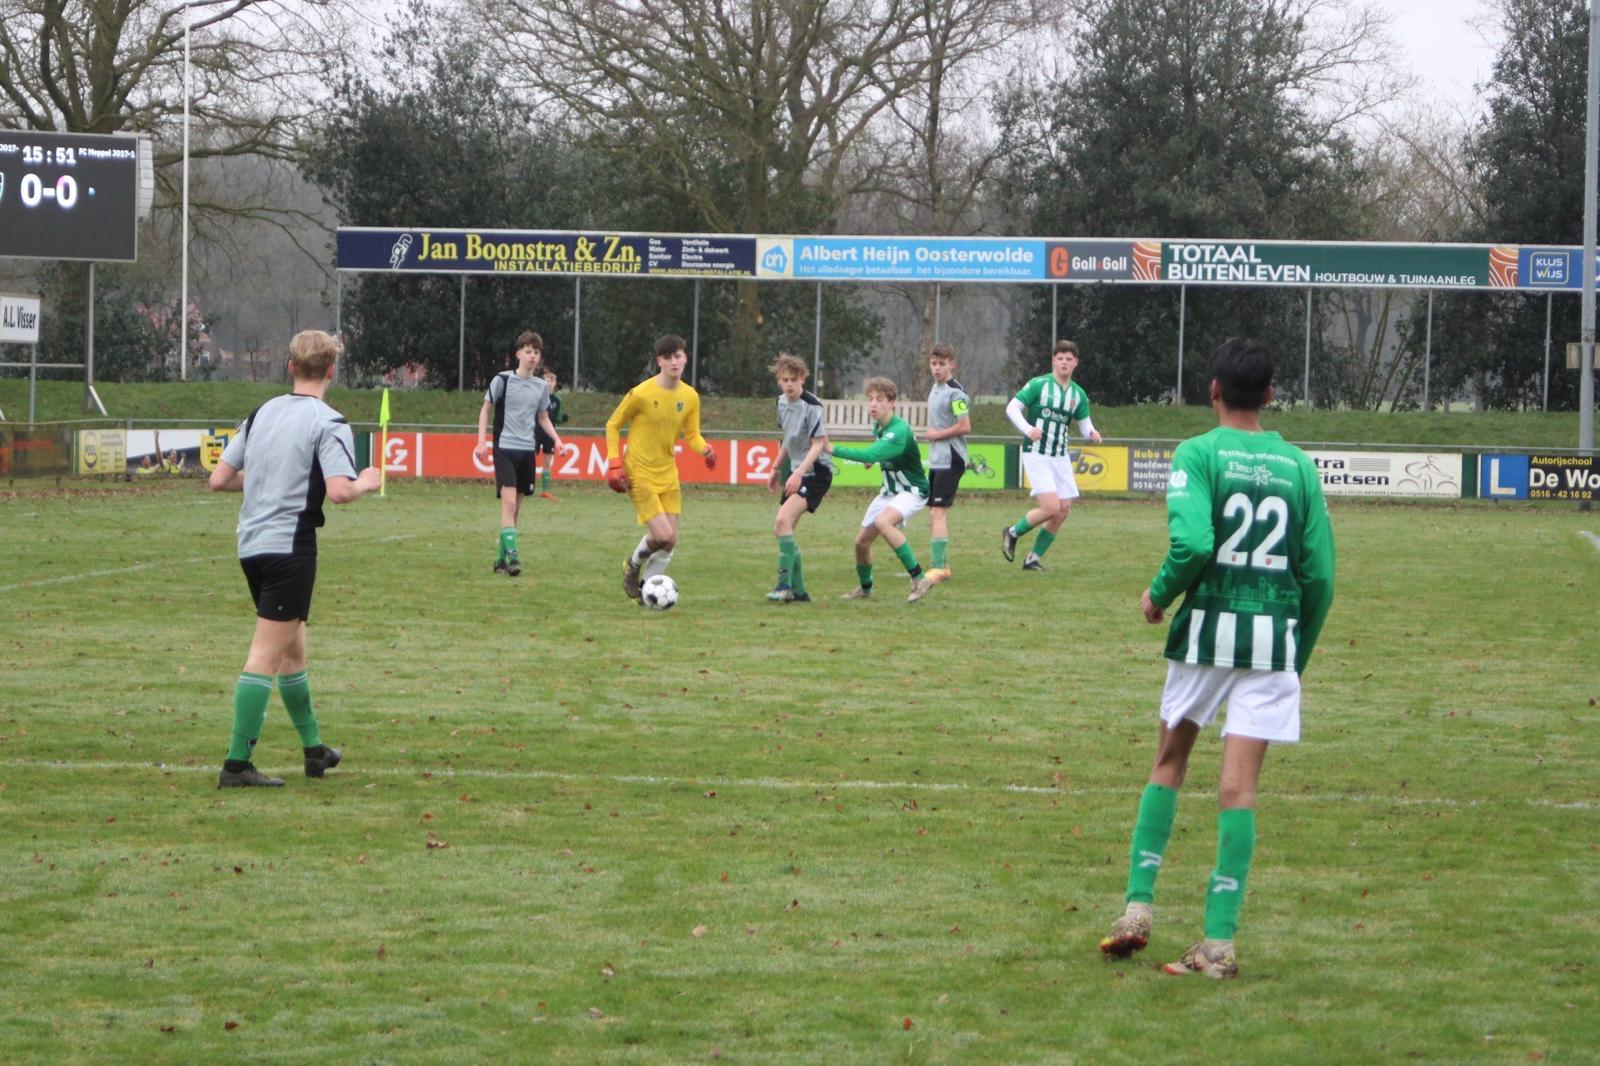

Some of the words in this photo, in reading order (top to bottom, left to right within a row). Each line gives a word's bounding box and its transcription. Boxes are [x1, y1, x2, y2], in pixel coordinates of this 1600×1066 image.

[20, 173, 78, 208] 0-0
[418, 233, 458, 260] Jan
[465, 234, 567, 261] Boonstra
[574, 236, 596, 262] &
[603, 236, 641, 262] Zn.
[800, 245, 858, 261] Albert
[863, 246, 910, 265] Heijn
[915, 247, 1034, 263] Oosterwolde
[1168, 244, 1262, 263] TOTAAL
[494, 261, 641, 273] INSTALLATIEBEDRIJF
[934, 266, 981, 276] bijzondere
[1536, 257, 1563, 267] KLUS
[1167, 263, 1310, 281] BUITENLEVEN
[1315, 272, 1385, 283] HOUTBOUW
[1388, 273, 1396, 283] &
[1400, 274, 1476, 286] TUINAANLEG
[1536, 269, 1563, 279] WIJS
[17, 305, 37, 329] Visser
[1133, 449, 1160, 459] Hubo
[1532, 456, 1593, 466] Autorijschool
[1133, 471, 1171, 480] Haulerwi
[1490, 458, 1516, 495] L
[1529, 468, 1559, 488] De
[1557, 490, 1568, 498] 42
[1570, 490, 1580, 498] 16
[1581, 490, 1592, 498] 92
[1216, 492, 1288, 570] 22
